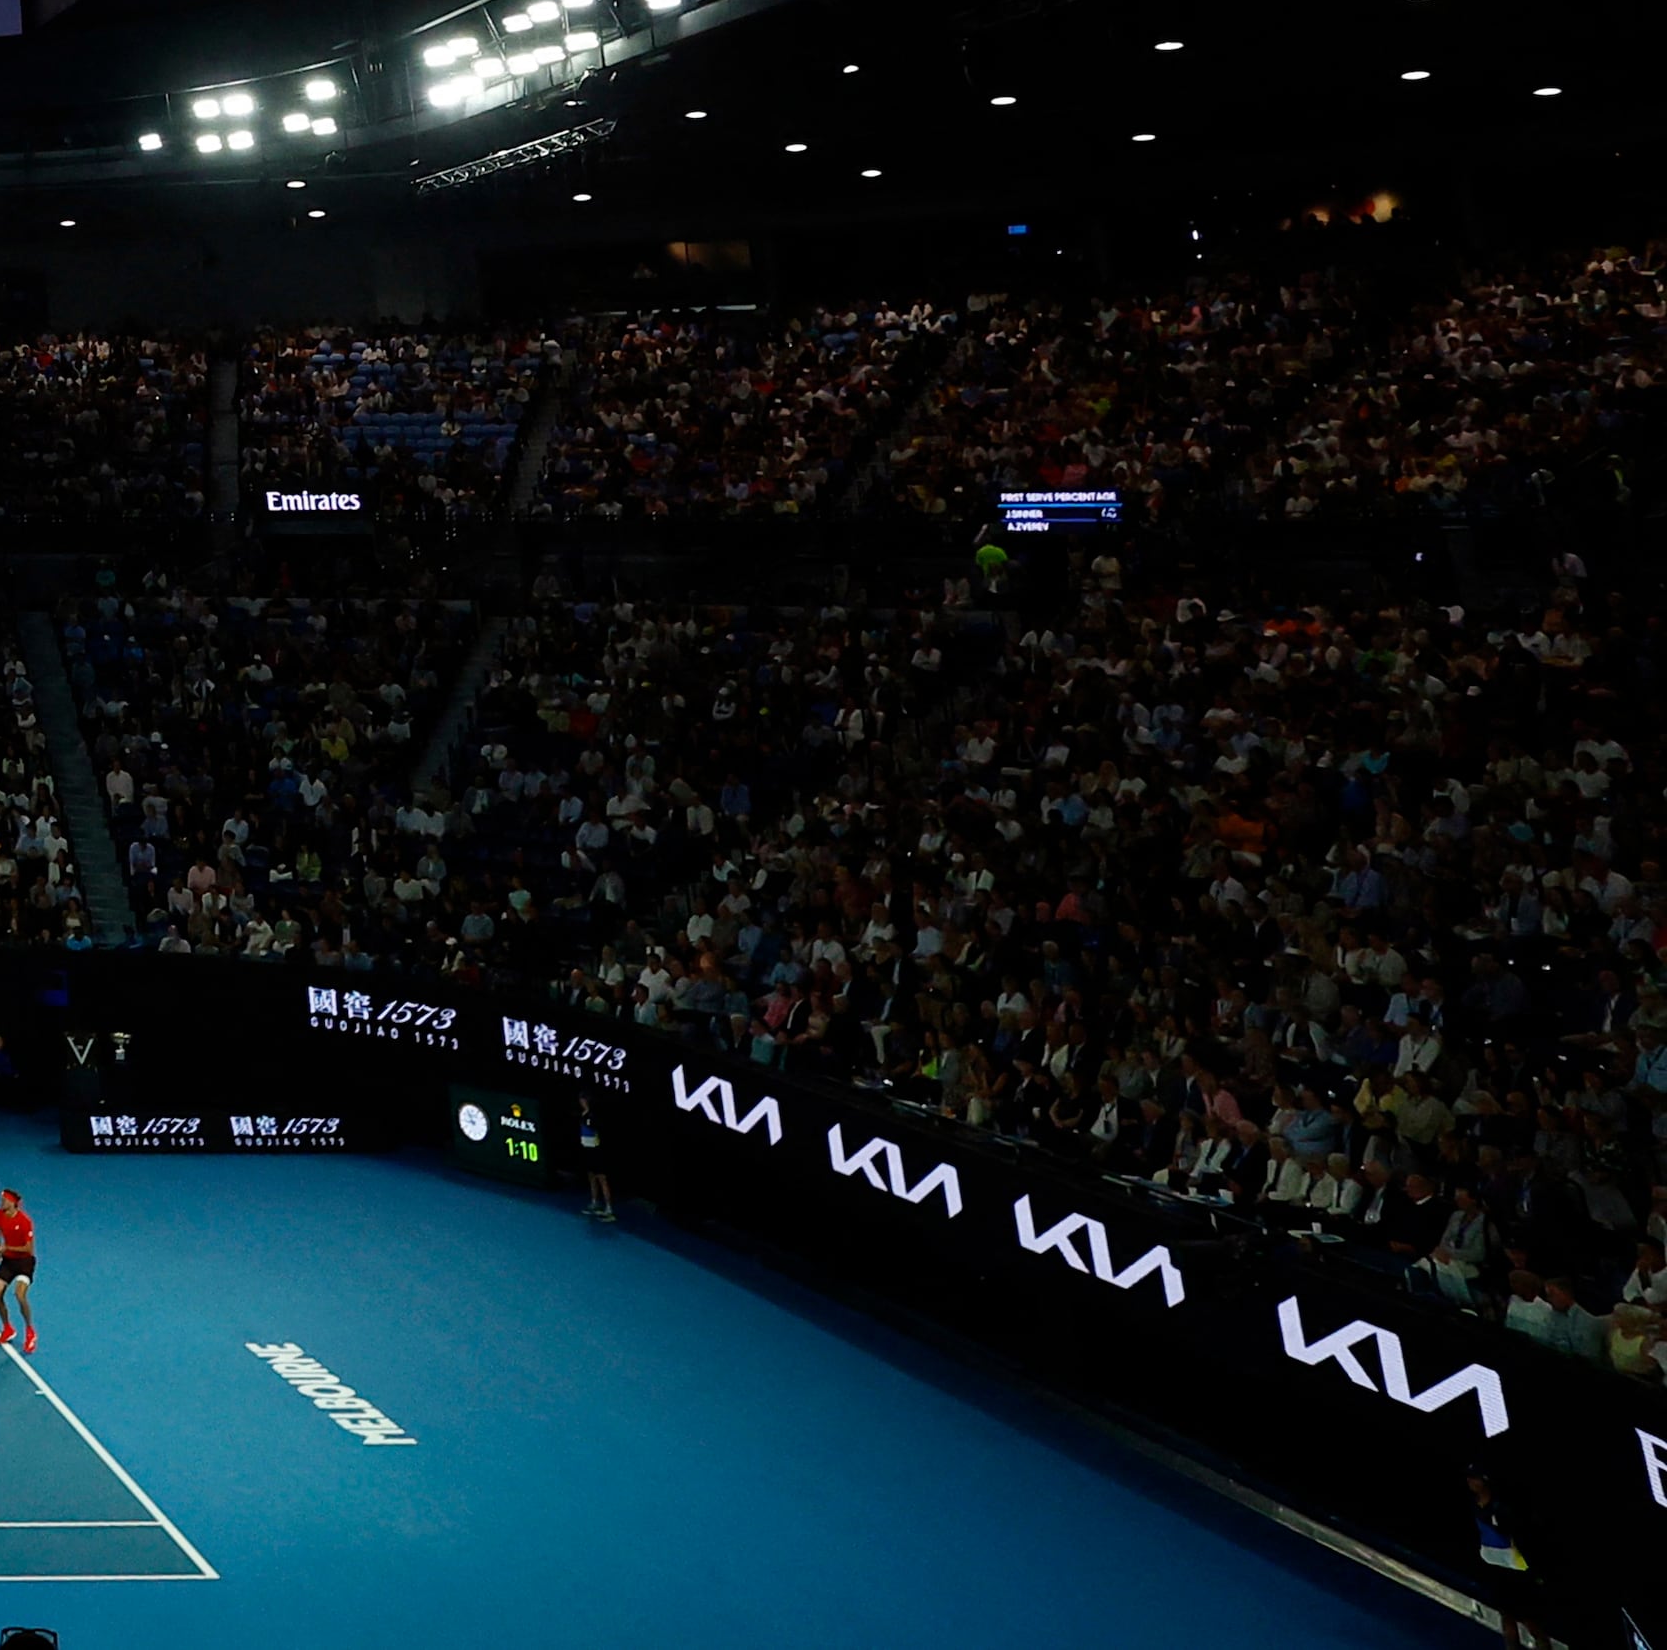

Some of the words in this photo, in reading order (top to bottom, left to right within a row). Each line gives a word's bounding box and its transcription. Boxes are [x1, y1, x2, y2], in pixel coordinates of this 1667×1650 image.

[266, 490, 361, 511] Emirates
[377, 1000, 457, 1030] 1573
[562, 1036, 627, 1070] 1573
[672, 1064, 783, 1146] KIA
[141, 1117, 201, 1135] 1573
[282, 1117, 340, 1135] 1573
[500, 1115, 536, 1133] ROLEX
[505, 1137, 538, 1162] 1:10
[827, 1123, 963, 1218] KIA
[1014, 1188, 1193, 1308] KIA
[1277, 1295, 1509, 1438] KIA
[245, 1342, 417, 1445] MELBOURNE
